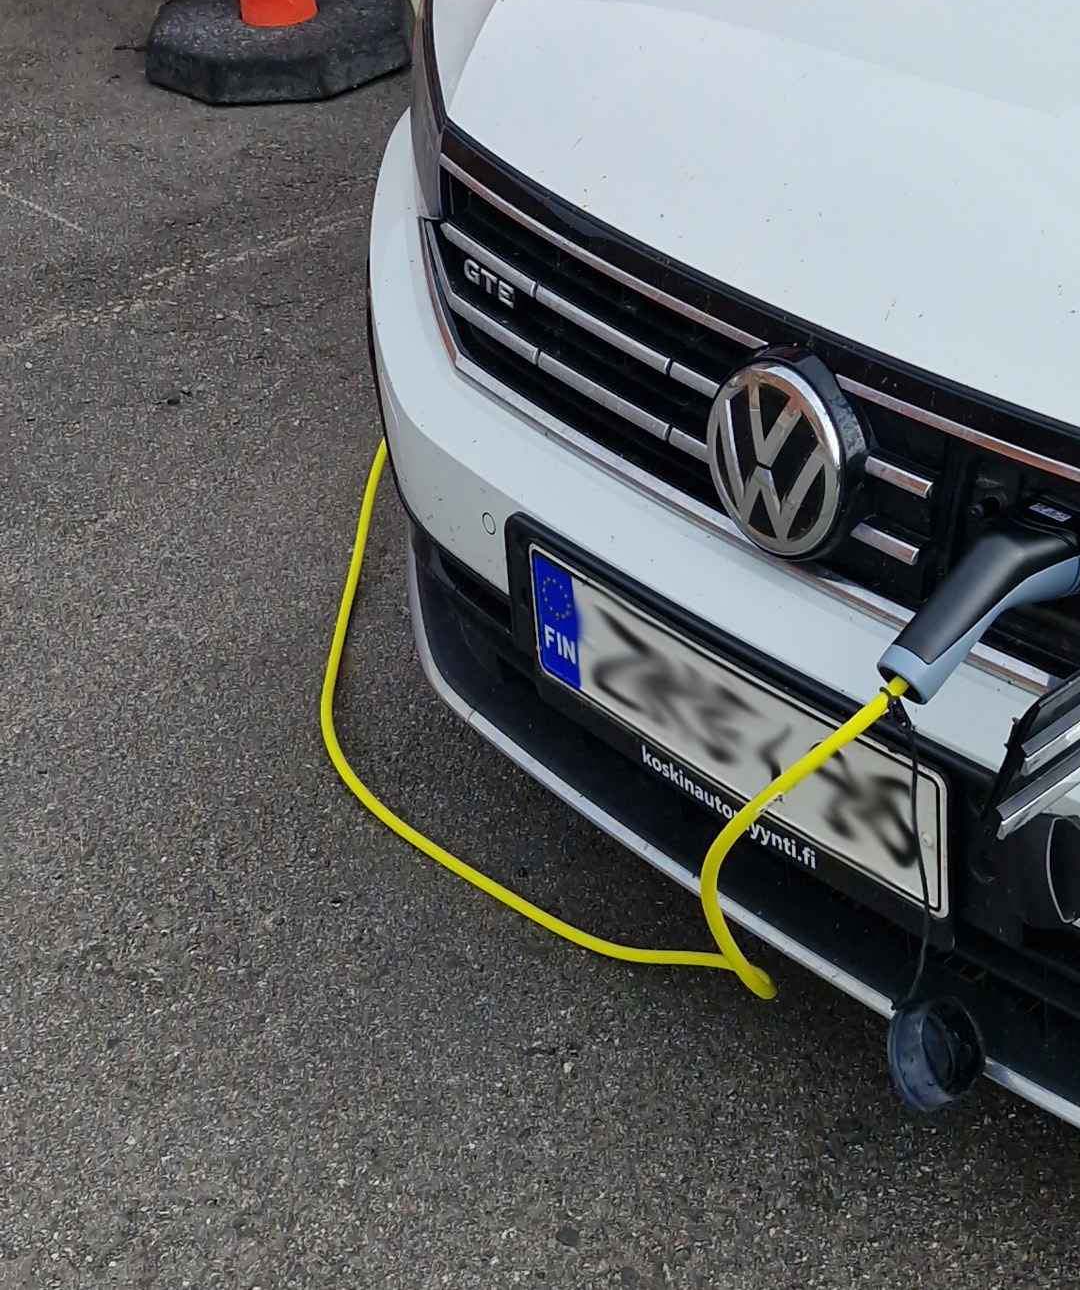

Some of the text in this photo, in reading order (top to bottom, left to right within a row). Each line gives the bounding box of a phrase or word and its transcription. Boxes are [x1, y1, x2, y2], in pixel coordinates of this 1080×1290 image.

[464, 258, 514, 309] GTE
[712, 366, 838, 554] VW
[544, 623, 576, 665] FIN
[641, 744, 817, 870] koskinautoyynti.fi
